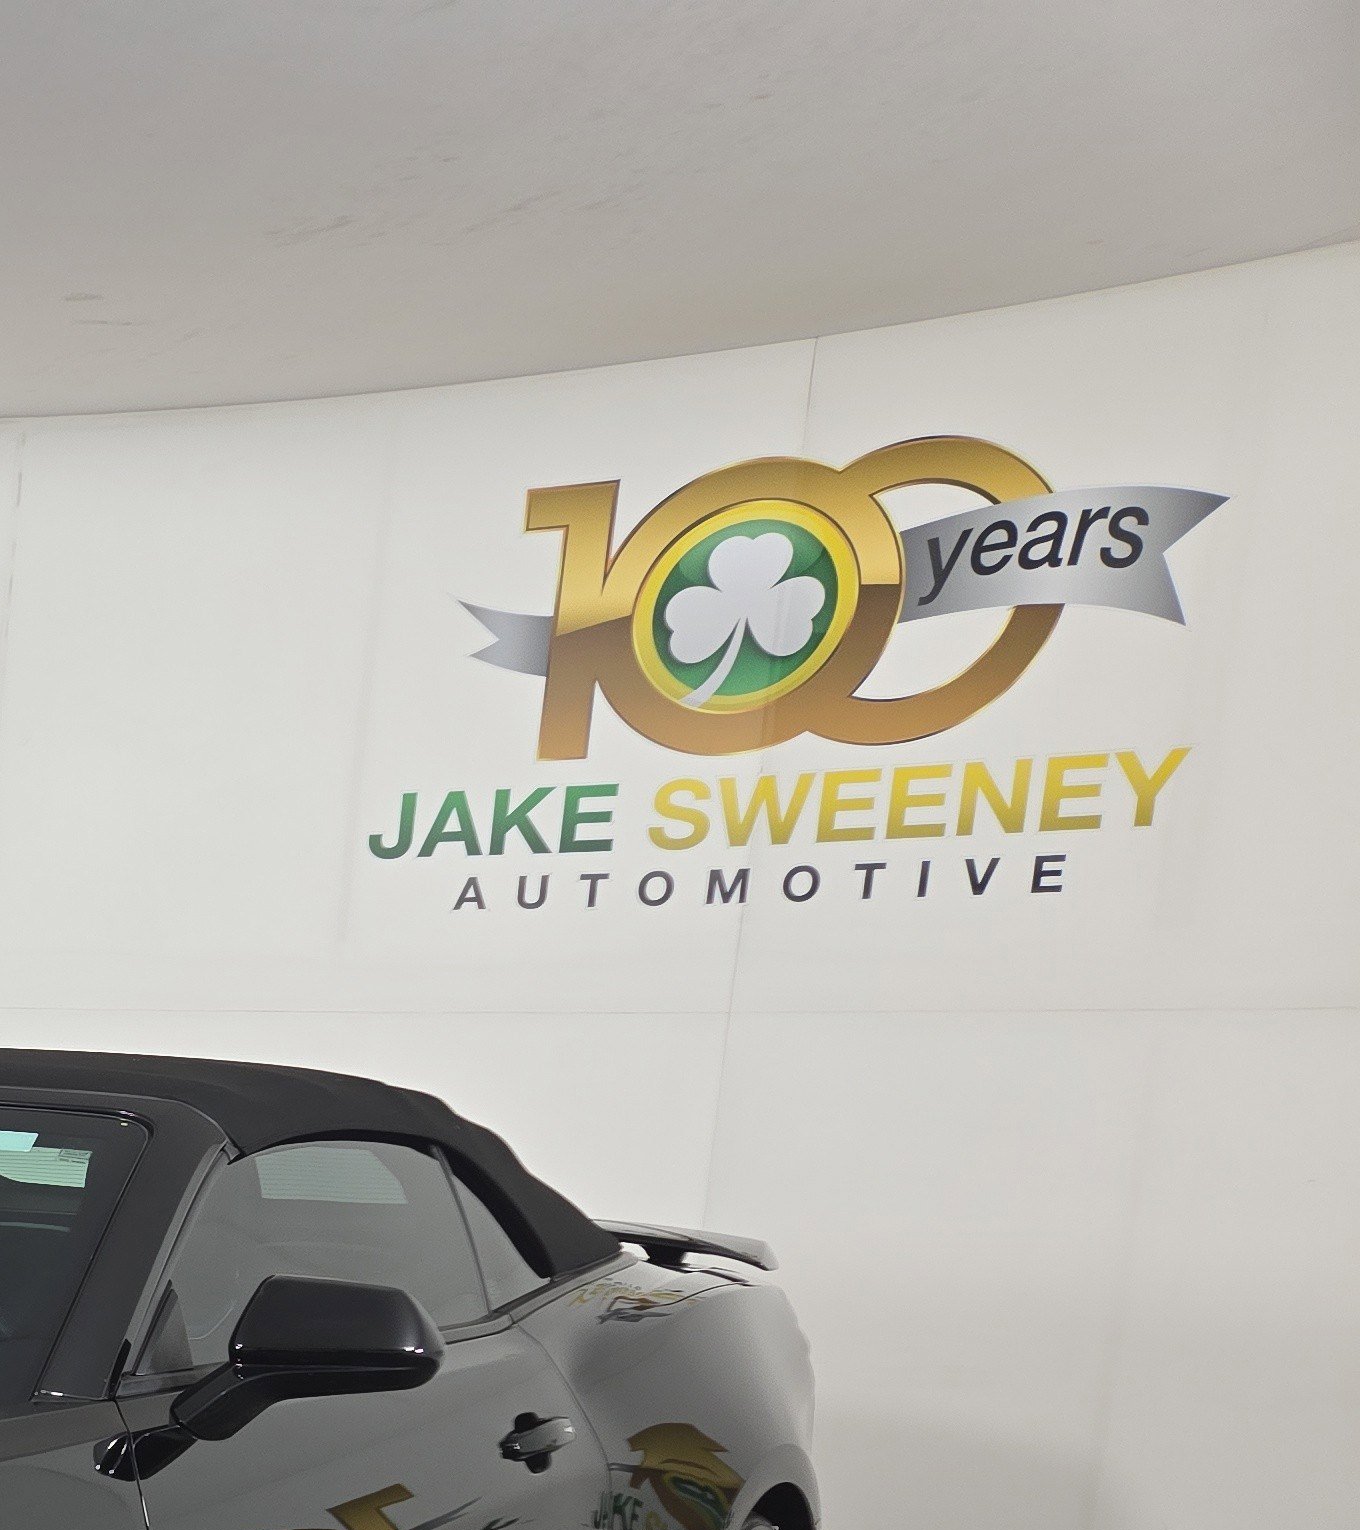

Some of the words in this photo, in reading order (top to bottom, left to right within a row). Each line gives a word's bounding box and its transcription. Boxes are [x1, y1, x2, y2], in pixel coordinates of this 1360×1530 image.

[524, 434, 1065, 761] 100
[918, 504, 1150, 606] years
[367, 782, 620, 861] JAKE
[646, 746, 1191, 852] SWEENEY
[452, 853, 1067, 912] AUTOMOTIVE
